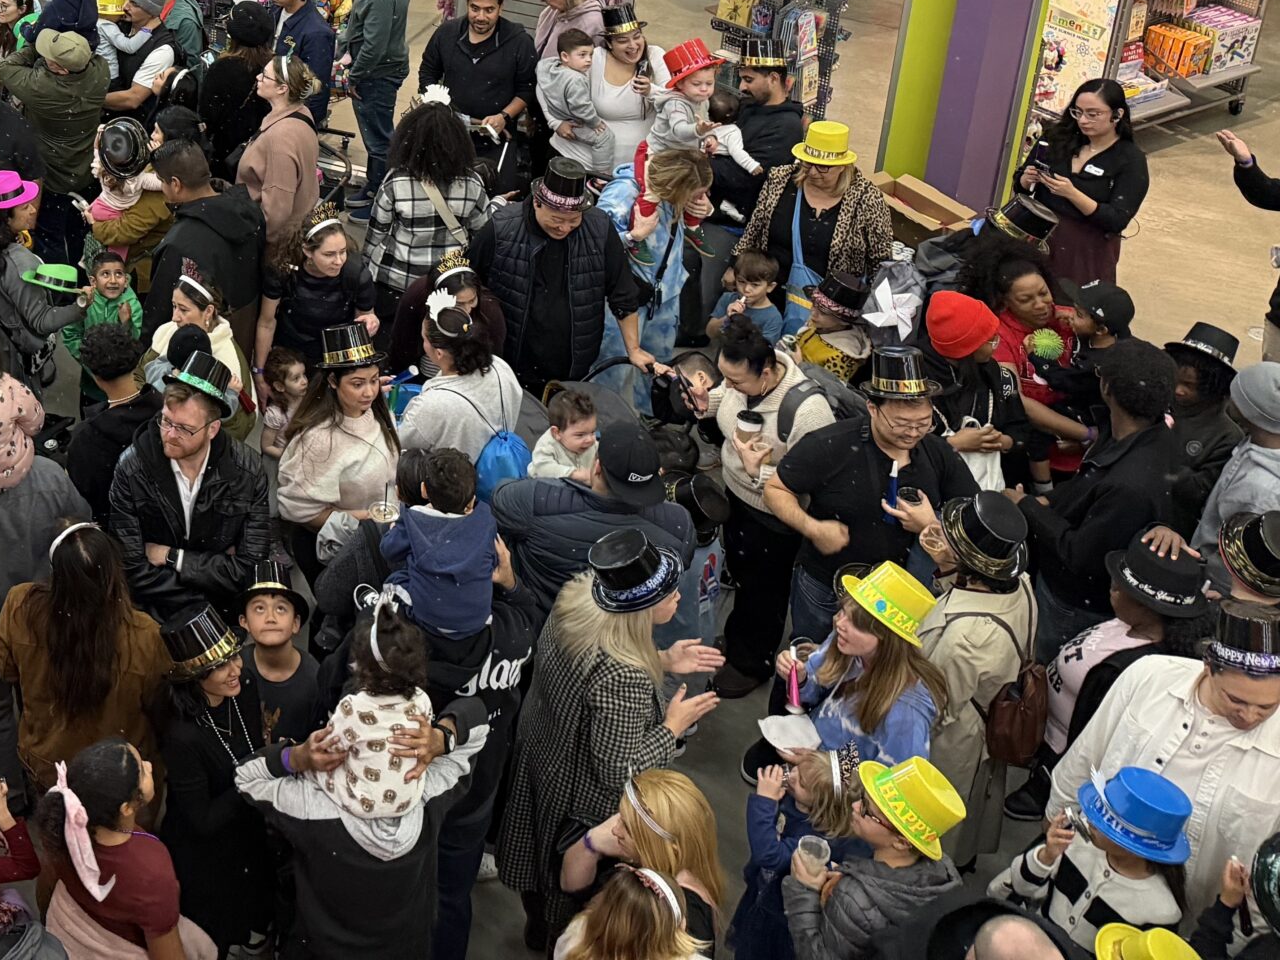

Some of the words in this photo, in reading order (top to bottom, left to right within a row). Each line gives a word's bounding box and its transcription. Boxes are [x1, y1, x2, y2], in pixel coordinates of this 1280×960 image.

[805, 144, 819, 158] NEW
[881, 783, 937, 843] HAPPY
[1103, 805, 1126, 833] YEAR
